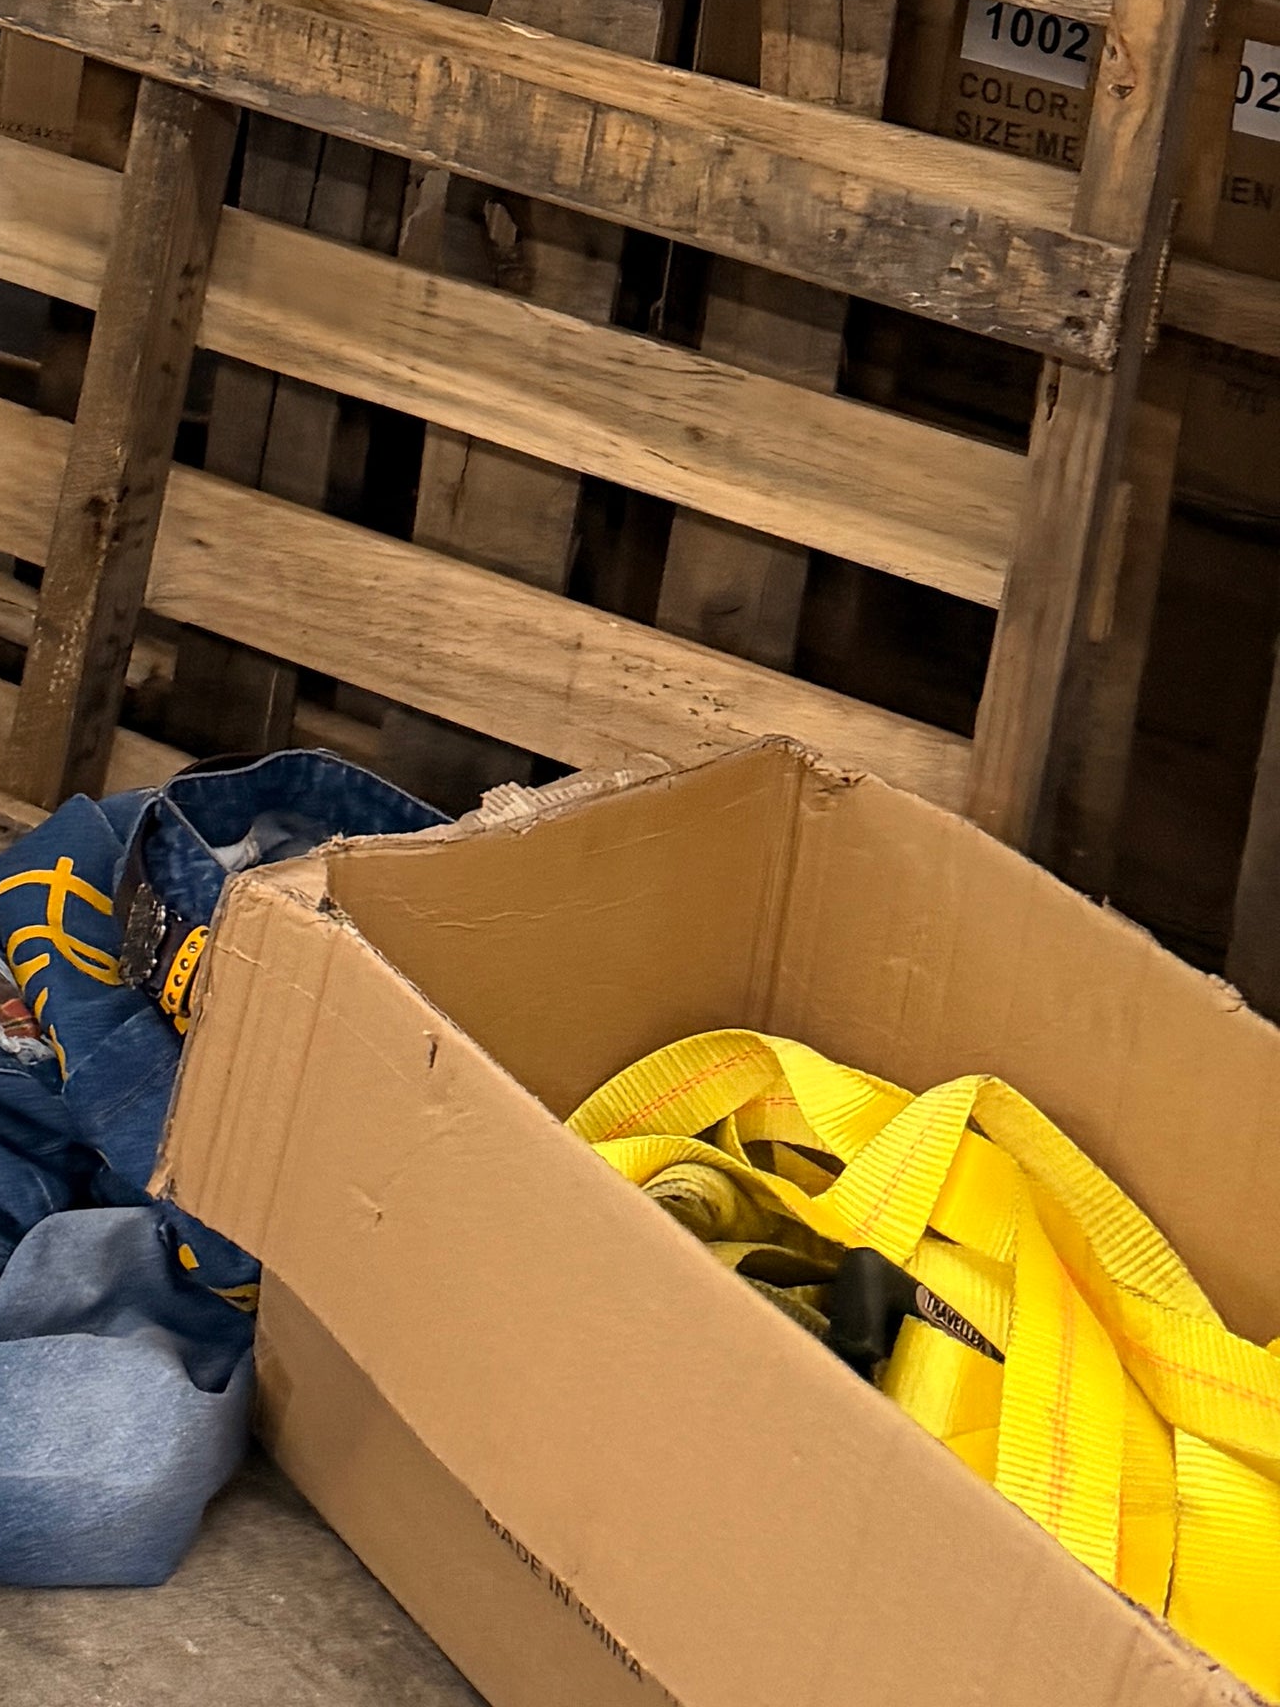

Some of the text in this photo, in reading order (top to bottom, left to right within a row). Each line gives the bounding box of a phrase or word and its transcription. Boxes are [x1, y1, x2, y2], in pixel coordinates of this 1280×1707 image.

[985, 2, 1091, 63] 1002
[959, 71, 1079, 124] COLOR:
[484, 1507, 644, 1683] MADE IN CHINA
